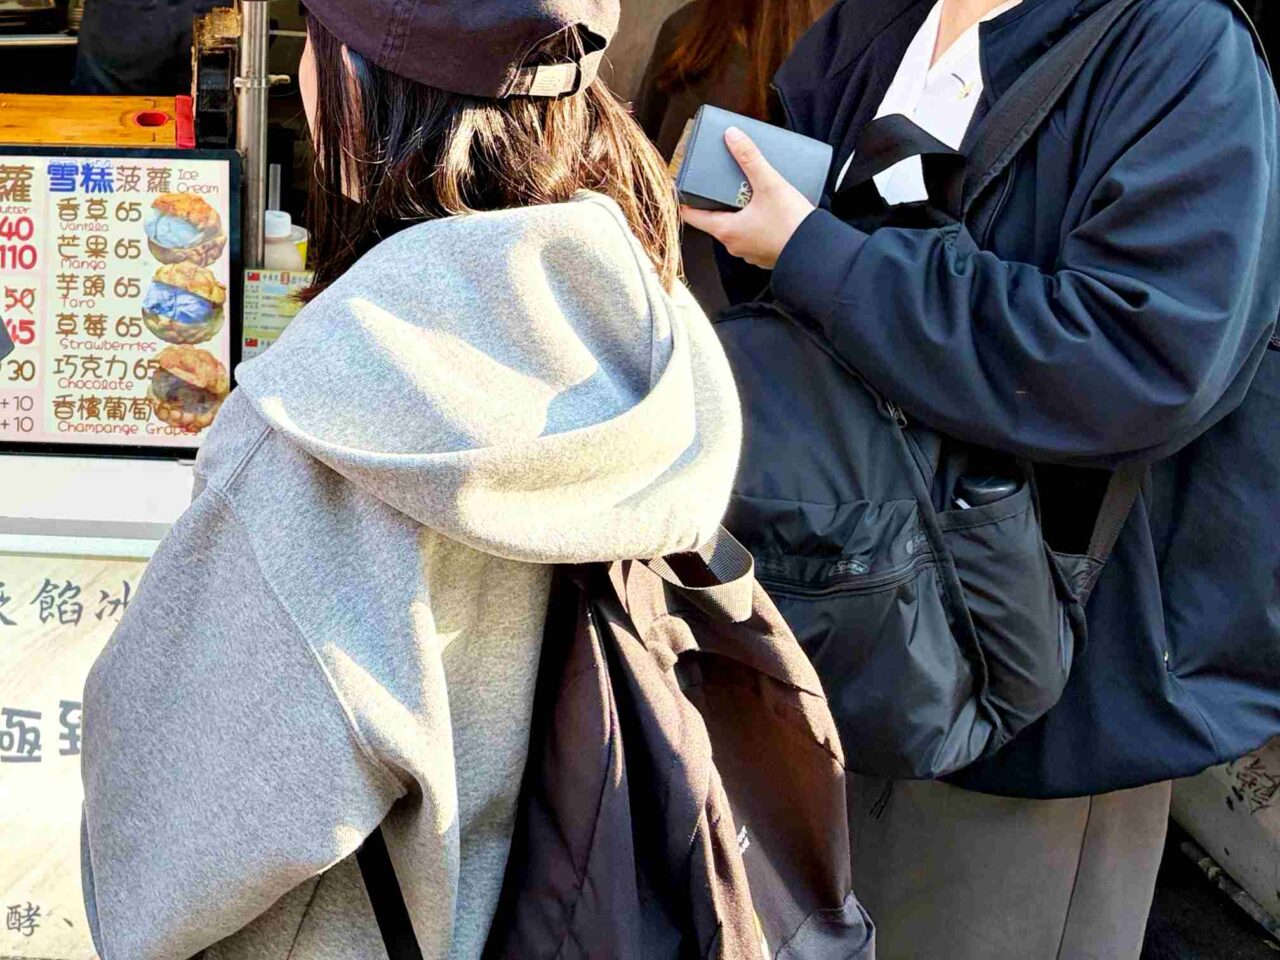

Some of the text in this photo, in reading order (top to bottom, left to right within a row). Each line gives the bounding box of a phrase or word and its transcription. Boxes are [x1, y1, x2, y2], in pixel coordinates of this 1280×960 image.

[177, 168, 199, 181] Ice
[177, 183, 219, 194] Cream
[57, 197, 142, 222] 香草 65
[60, 222, 109, 232] Vanilla
[57, 234, 141, 259] 芒果 65
[60, 258, 107, 271] Mango
[56, 272, 141, 298] 芋頭 65
[59, 295, 96, 308] Taro
[55, 312, 143, 338] 草莓 65
[60, 338, 157, 351] Strawberries
[7, 359, 36, 382] 30
[52, 354, 128, 379] 巧克力
[58, 377, 134, 390] Chocolate
[52, 394, 154, 422] 香檳葡萄
[58, 421, 139, 436] Champange
